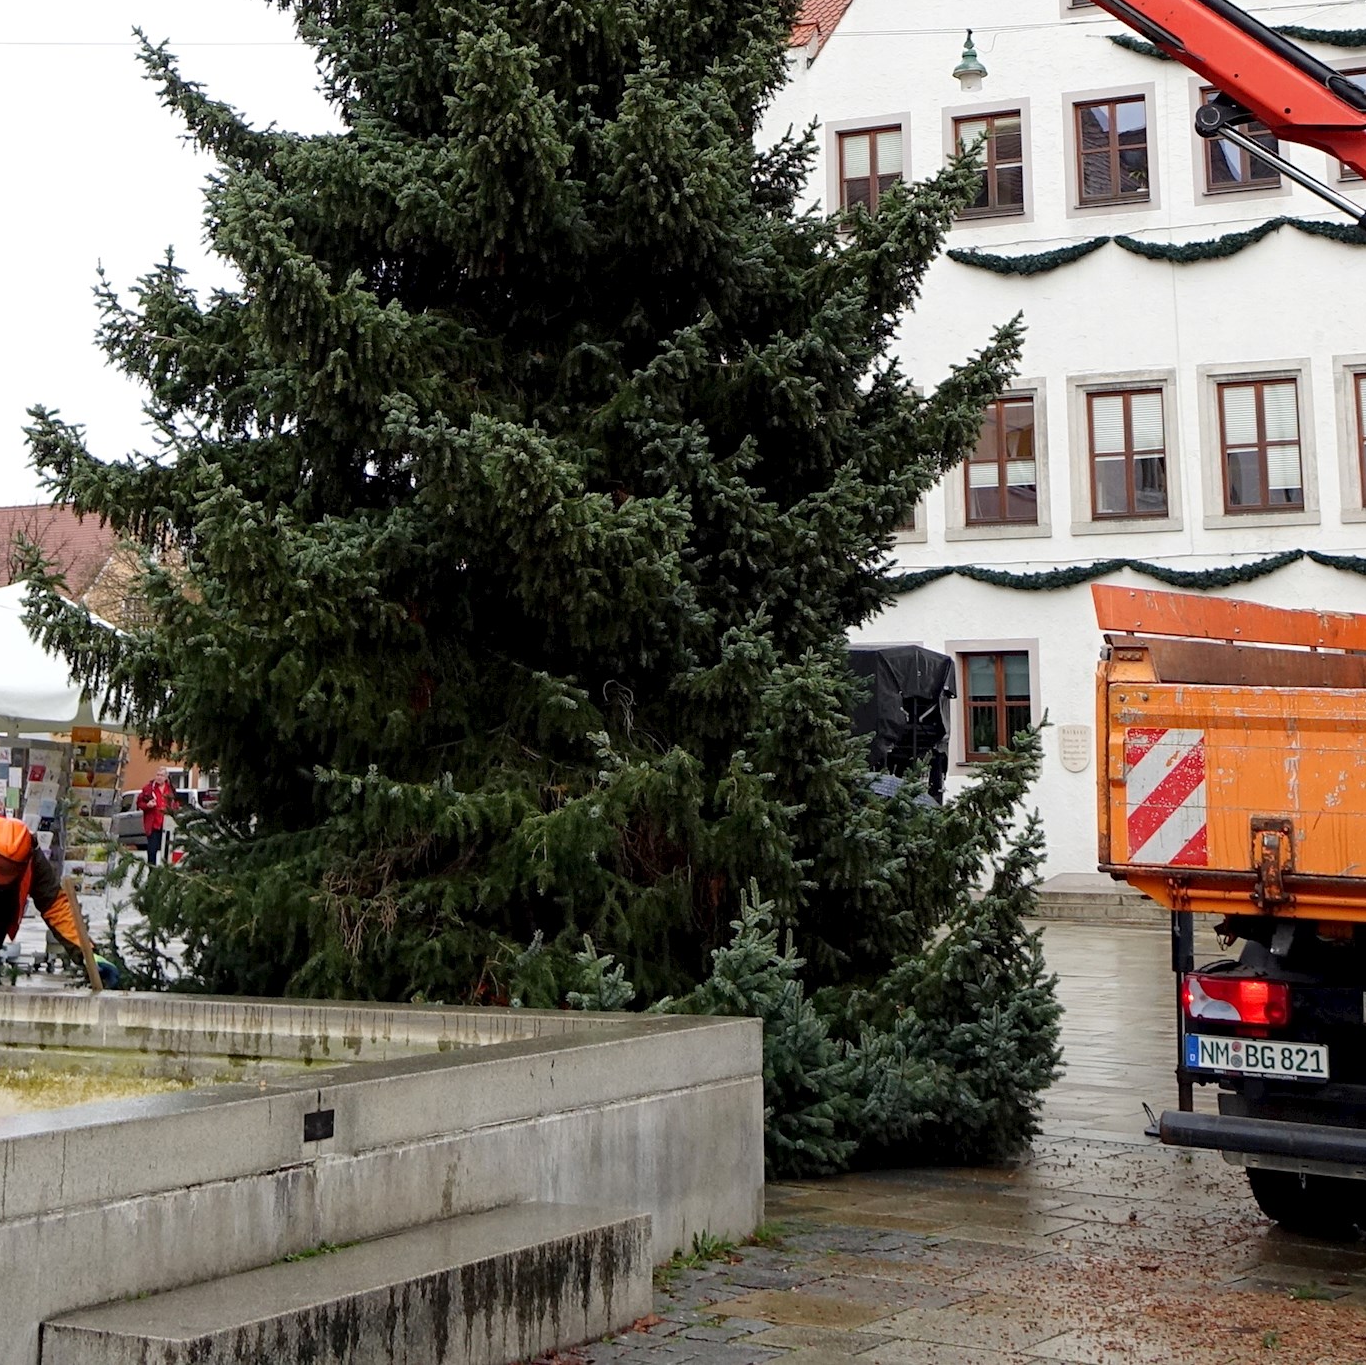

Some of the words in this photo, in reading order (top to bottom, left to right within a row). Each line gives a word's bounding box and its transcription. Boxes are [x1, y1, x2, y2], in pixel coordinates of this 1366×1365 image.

[1200, 1040, 1230, 1066] NM
[1245, 1044, 1276, 1070] BG
[1280, 1047, 1325, 1074] 821
